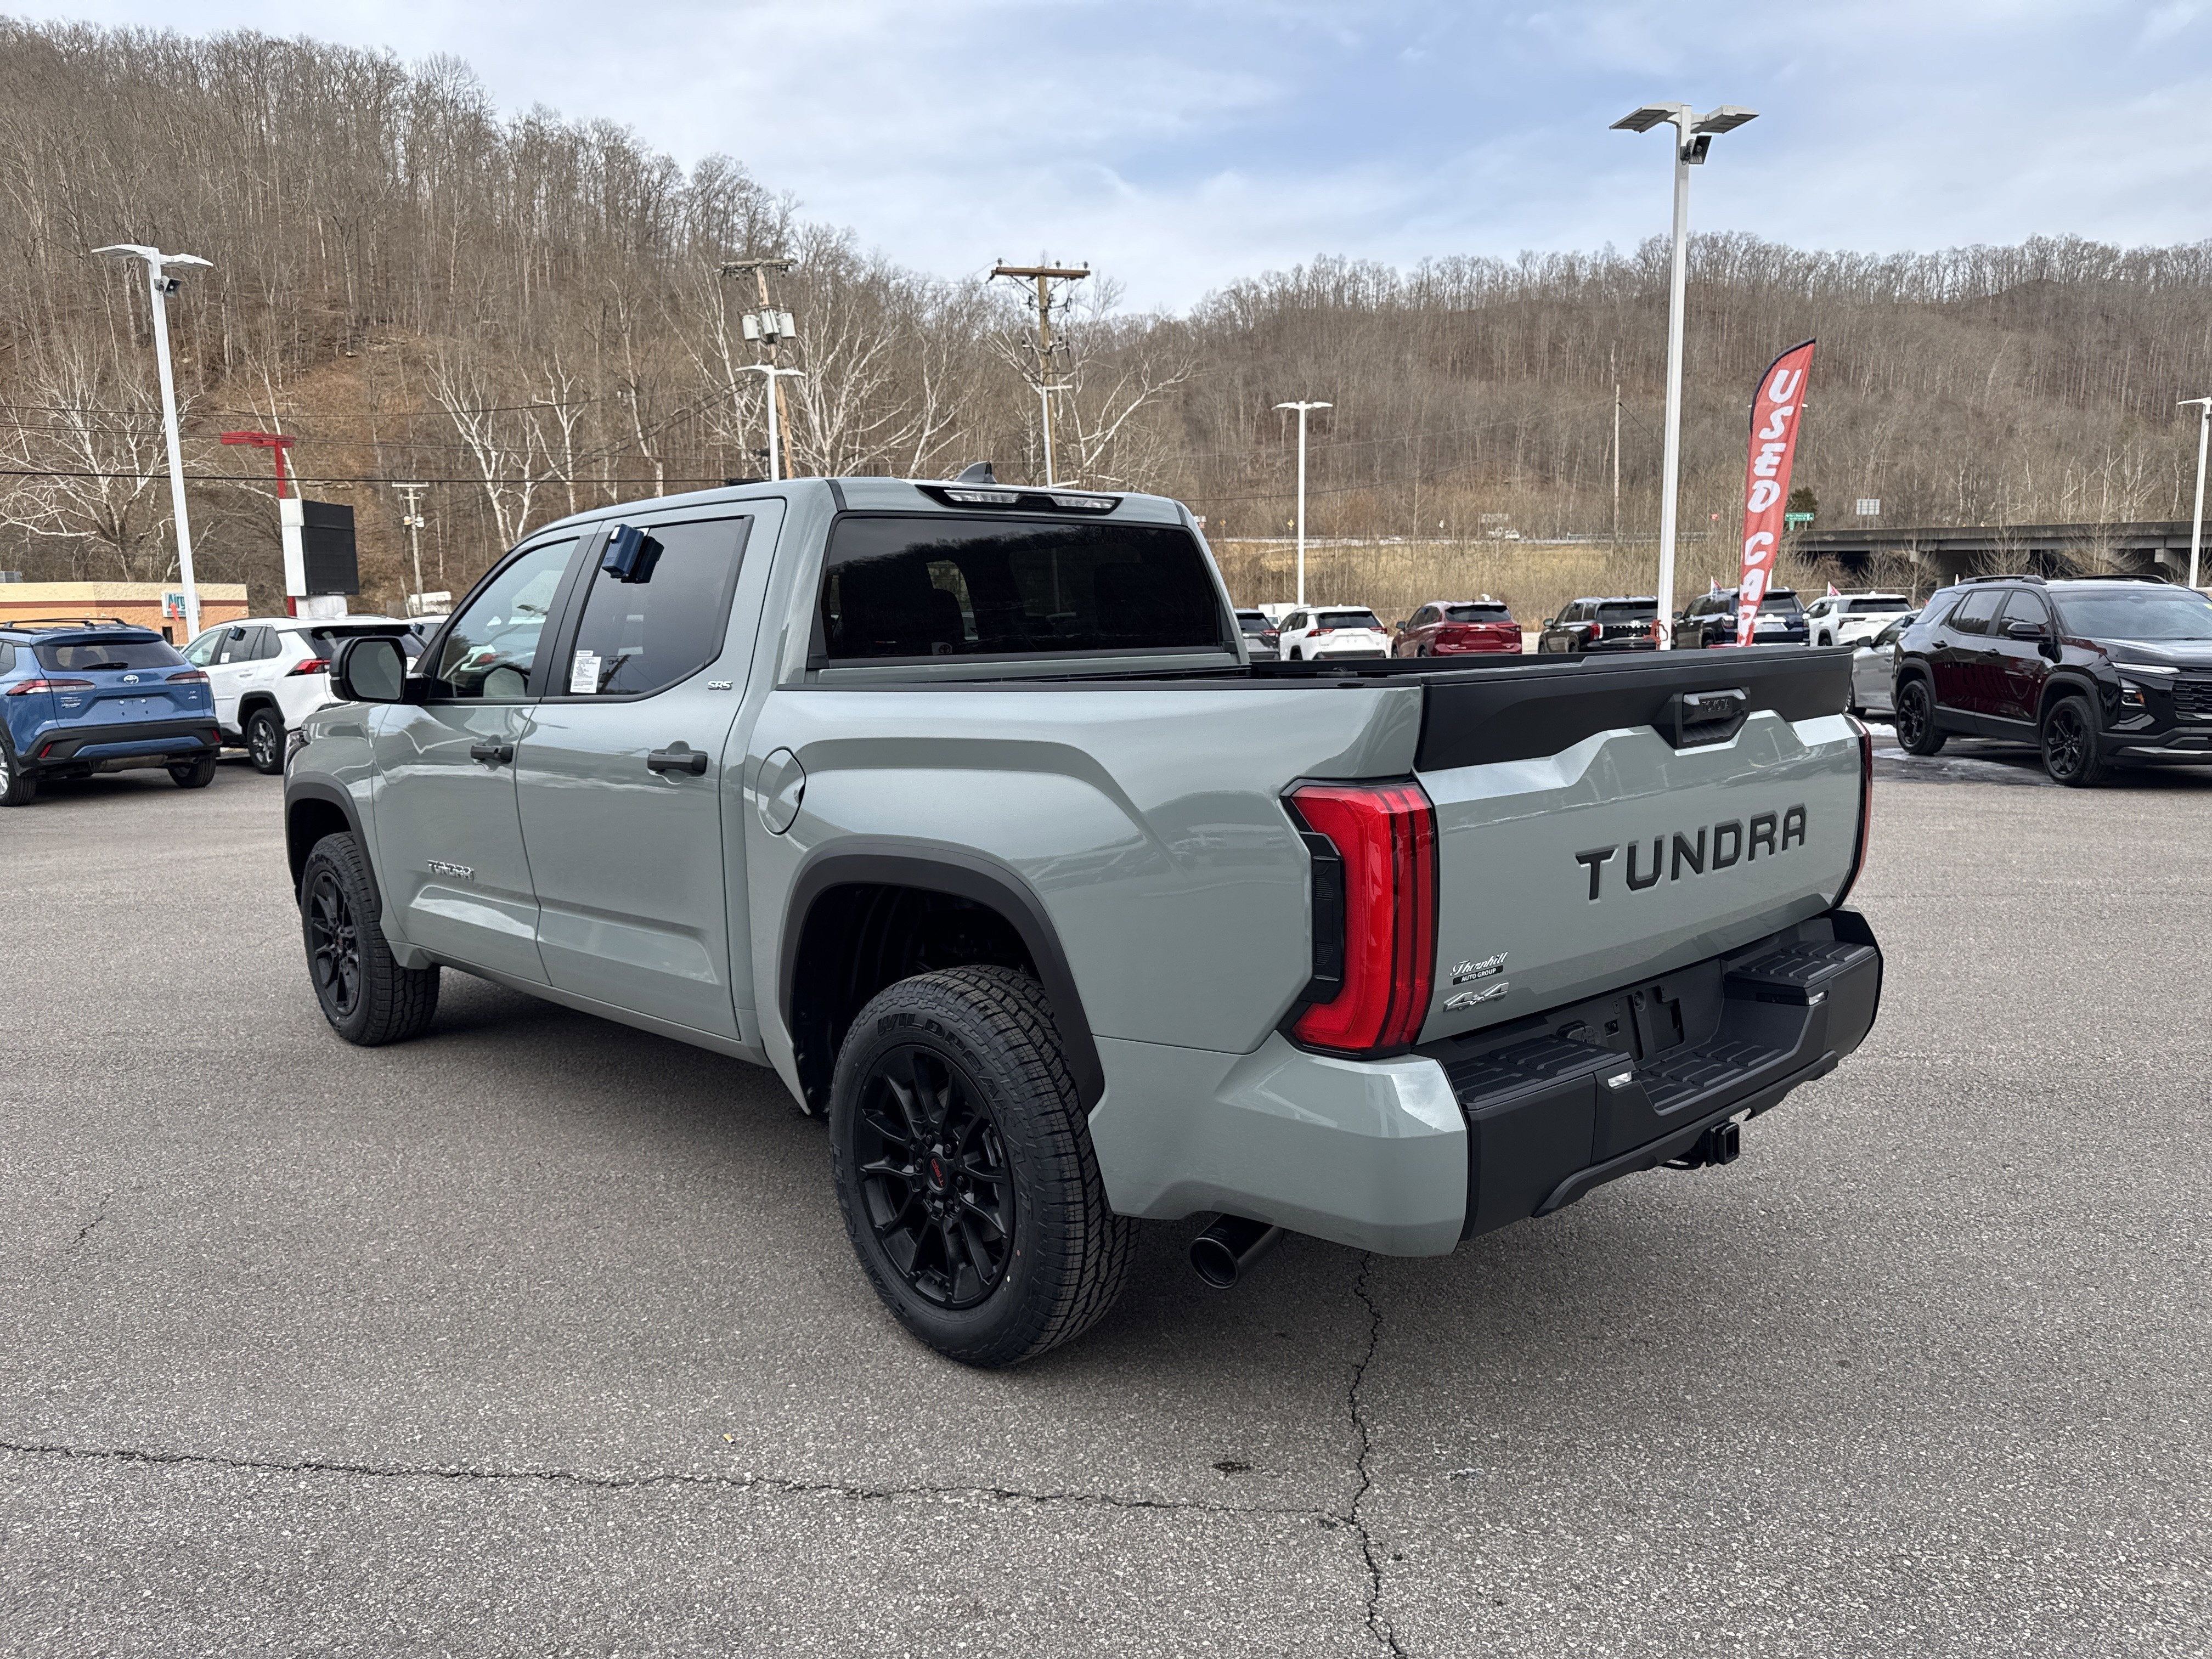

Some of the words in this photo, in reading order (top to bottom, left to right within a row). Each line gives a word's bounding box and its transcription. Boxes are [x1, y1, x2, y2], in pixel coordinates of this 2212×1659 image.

[1747, 369, 1802, 513] USED
[1737, 531, 1774, 647] CAR
[168, 594, 185, 610] Airg
[708, 680, 732, 690] SR5
[1575, 804, 1806, 901] TUNDRA
[1449, 951, 1508, 976] Thornhill
[1461, 974, 1477, 983] AUTO
[1477, 968, 1497, 978] GROUP
